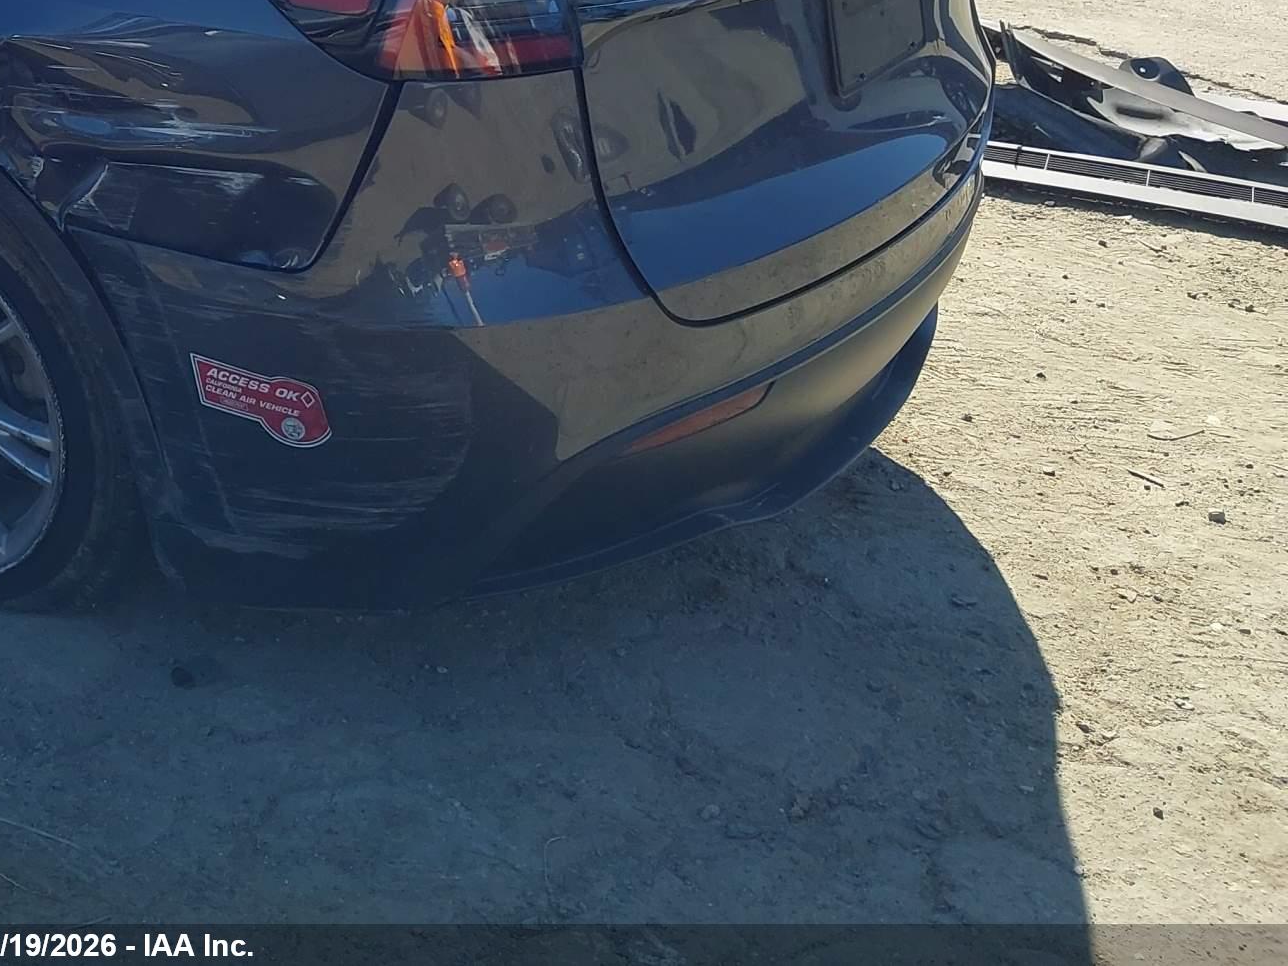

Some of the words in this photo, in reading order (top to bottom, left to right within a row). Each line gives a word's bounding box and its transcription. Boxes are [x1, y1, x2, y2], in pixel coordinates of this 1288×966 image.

[206, 377, 243, 393] CALIFORNIA
[206, 384, 237, 399] CLEAN
[240, 395, 256, 405] AIR
[260, 400, 301, 416] VEHICLE
[207, 367, 270, 393] ACCESS
[275, 388, 301, 402] OK
